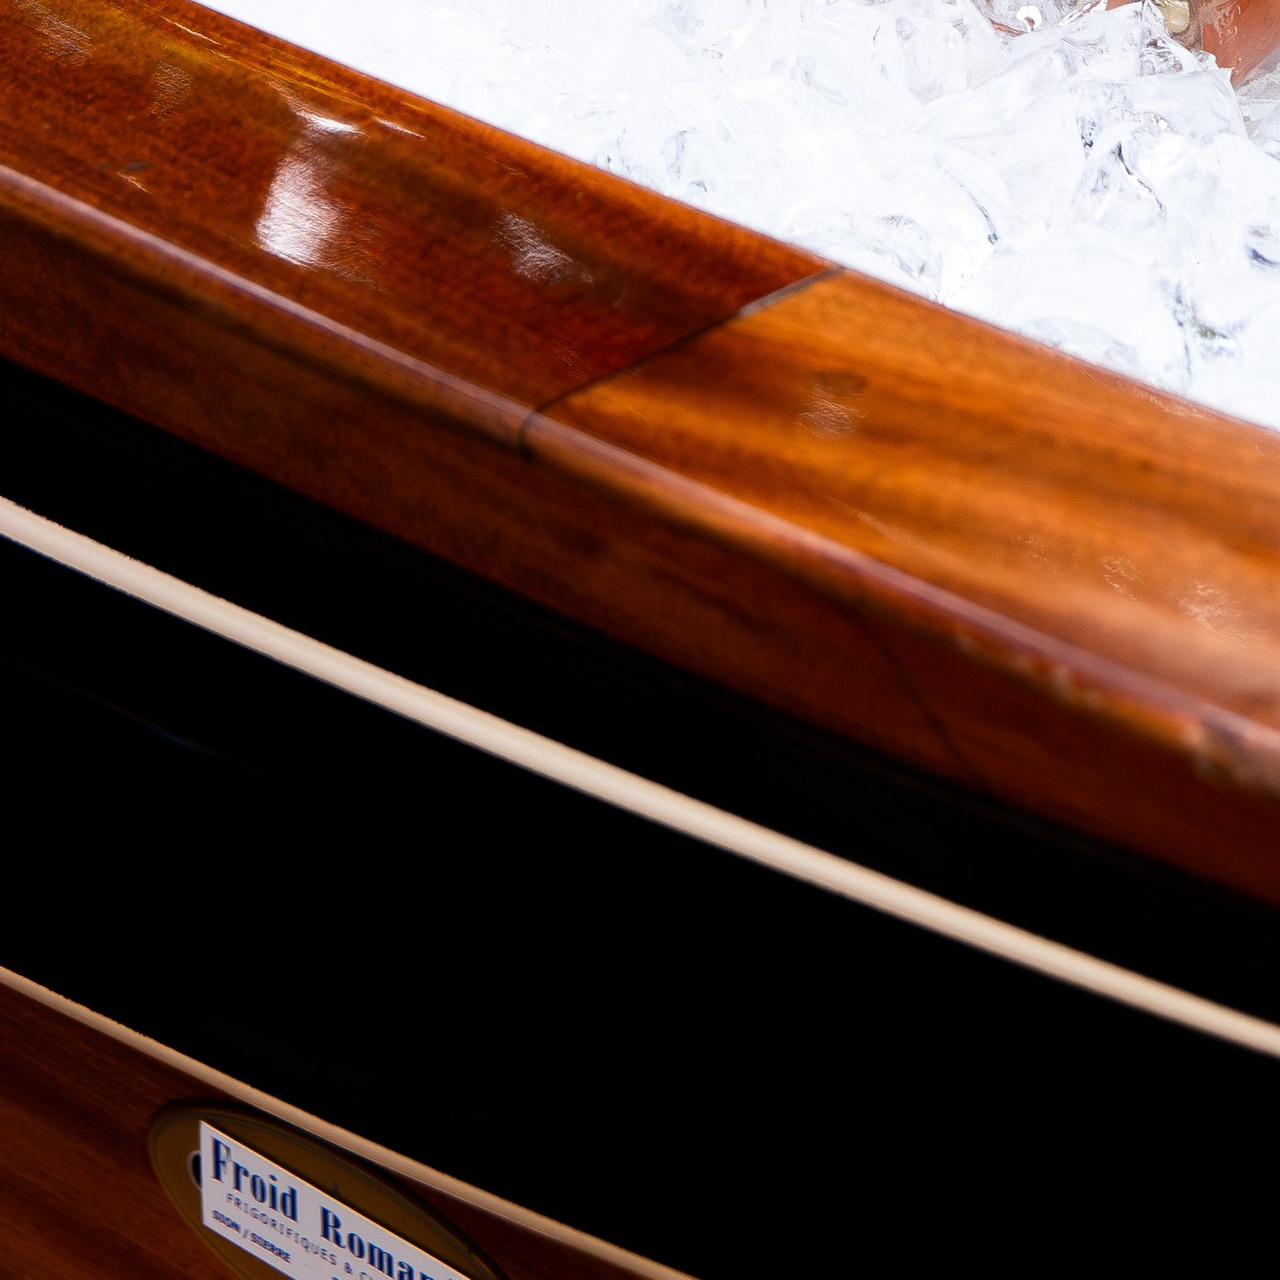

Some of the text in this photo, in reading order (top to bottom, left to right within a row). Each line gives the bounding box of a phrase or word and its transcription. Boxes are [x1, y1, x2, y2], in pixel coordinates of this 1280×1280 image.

[211, 1135, 452, 1280] Froid Roma
[226, 1192, 338, 1266] FRIGORIFIQUES
